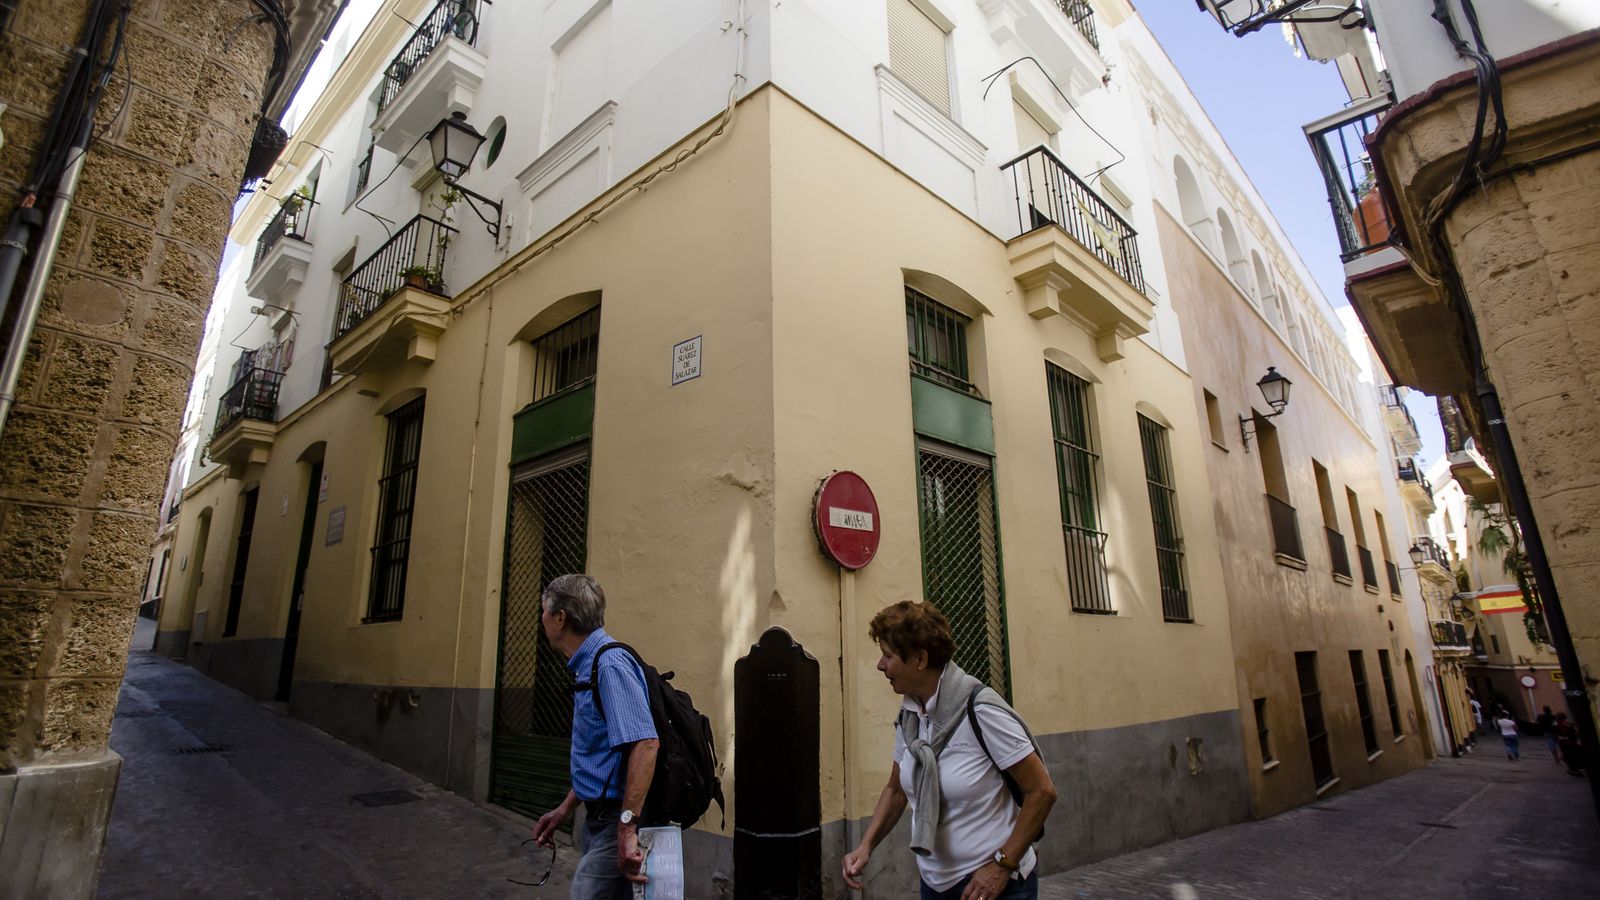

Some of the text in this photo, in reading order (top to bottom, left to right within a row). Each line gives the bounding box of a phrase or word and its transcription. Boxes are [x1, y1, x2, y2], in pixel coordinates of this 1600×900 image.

[680, 343, 695, 353] CALLE
[683, 360, 690, 368] DE
[675, 367, 696, 379] SALAZAR
